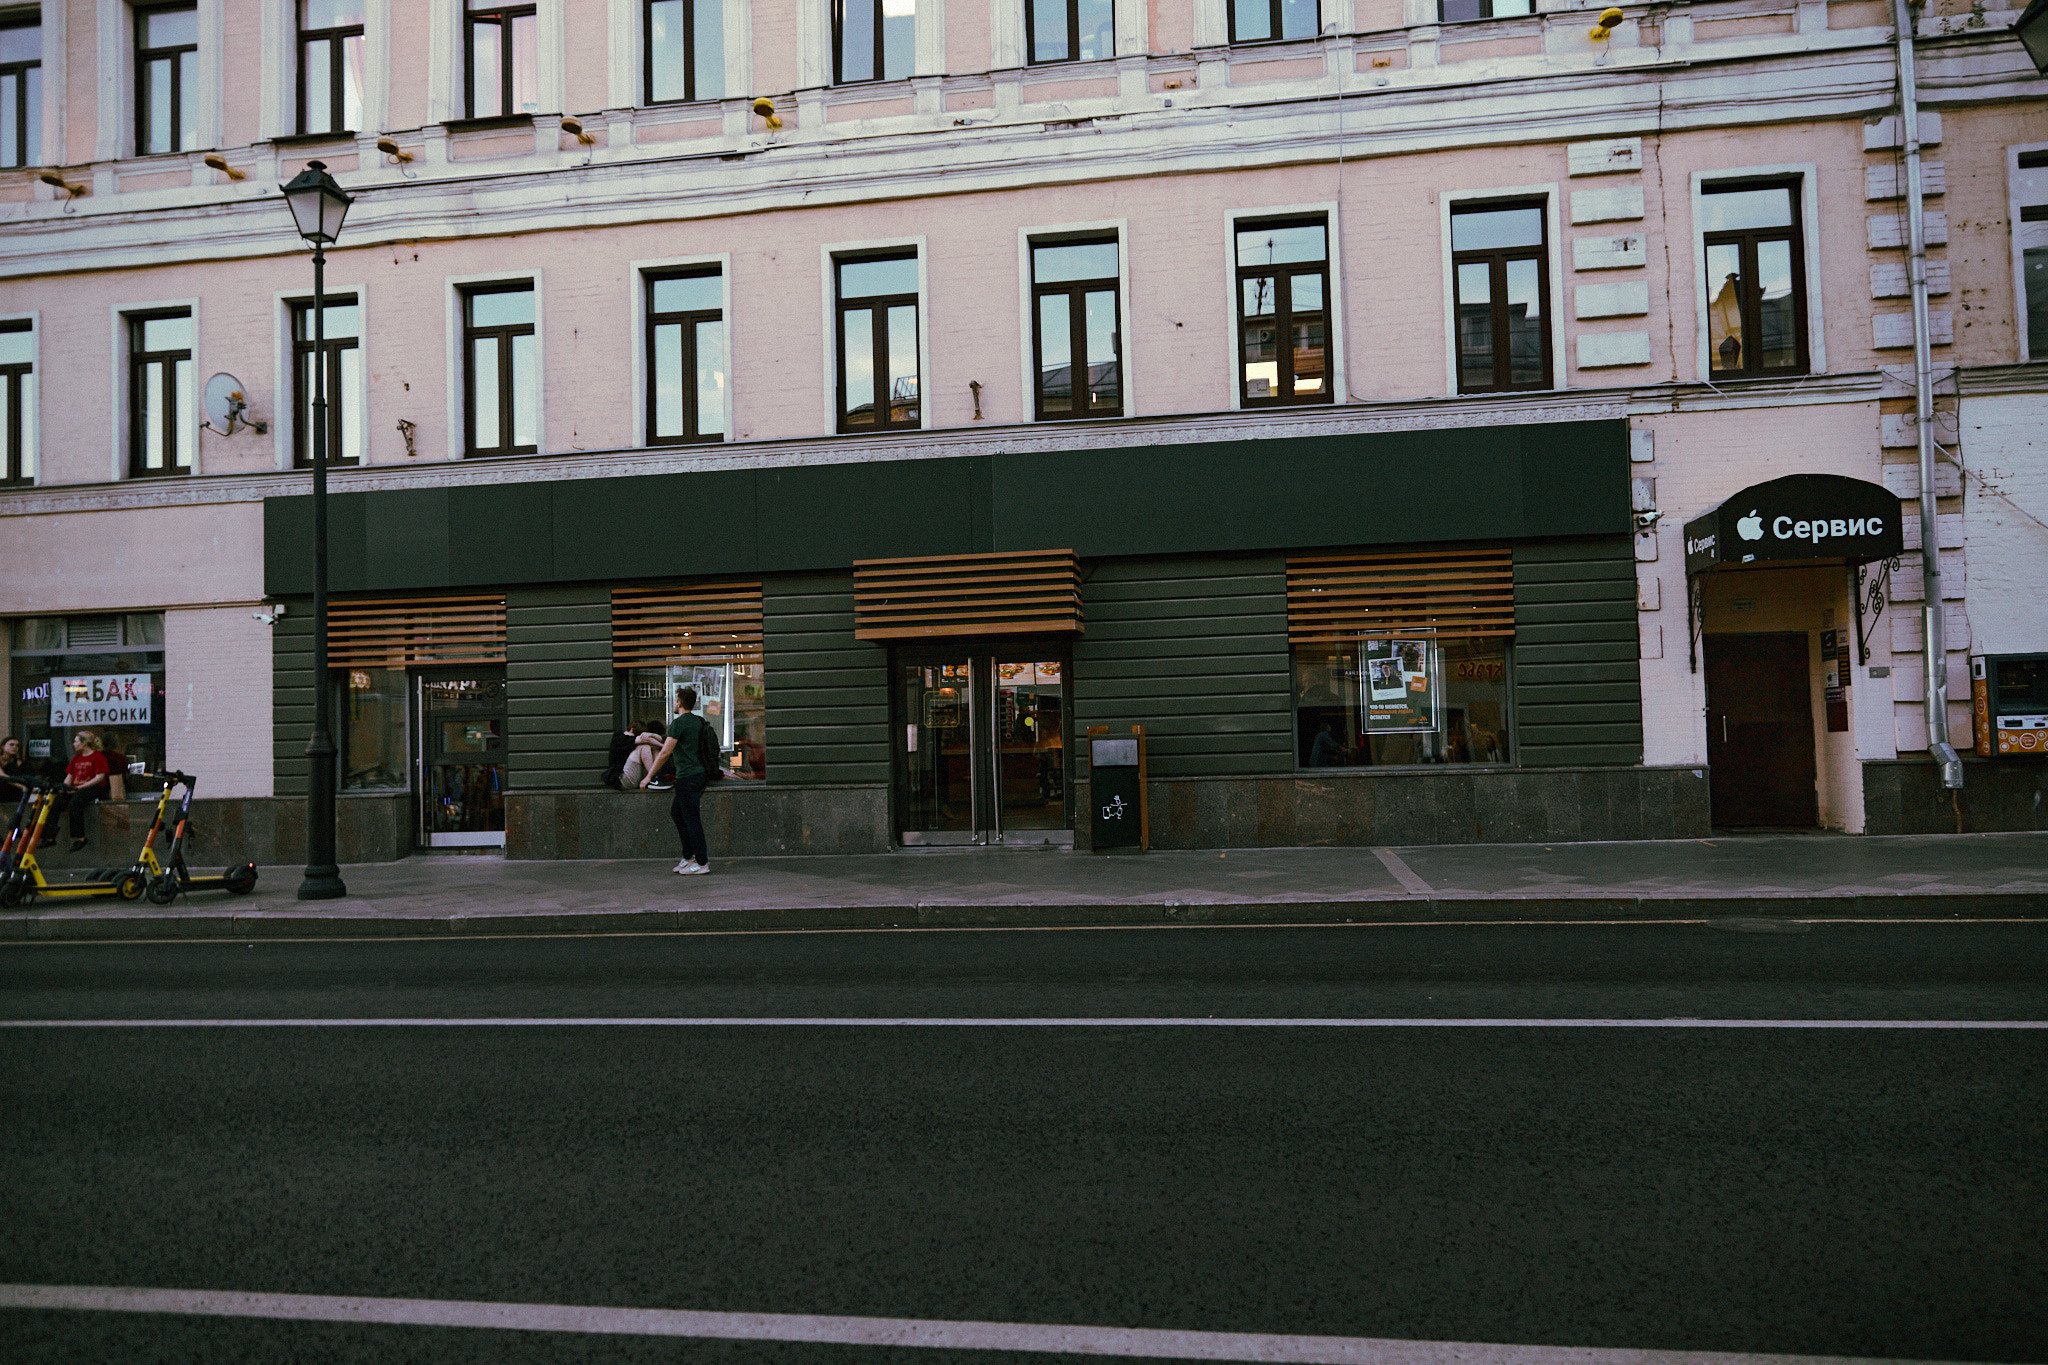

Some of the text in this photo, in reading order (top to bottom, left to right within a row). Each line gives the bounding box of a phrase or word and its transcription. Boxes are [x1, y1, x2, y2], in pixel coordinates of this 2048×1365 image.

[1772, 516, 1883, 543] Сервис
[1693, 534, 1716, 553] Сервис
[62, 678, 138, 703] ТАБАК
[55, 707, 147, 724] ЭЛЕКТРОНКИ
